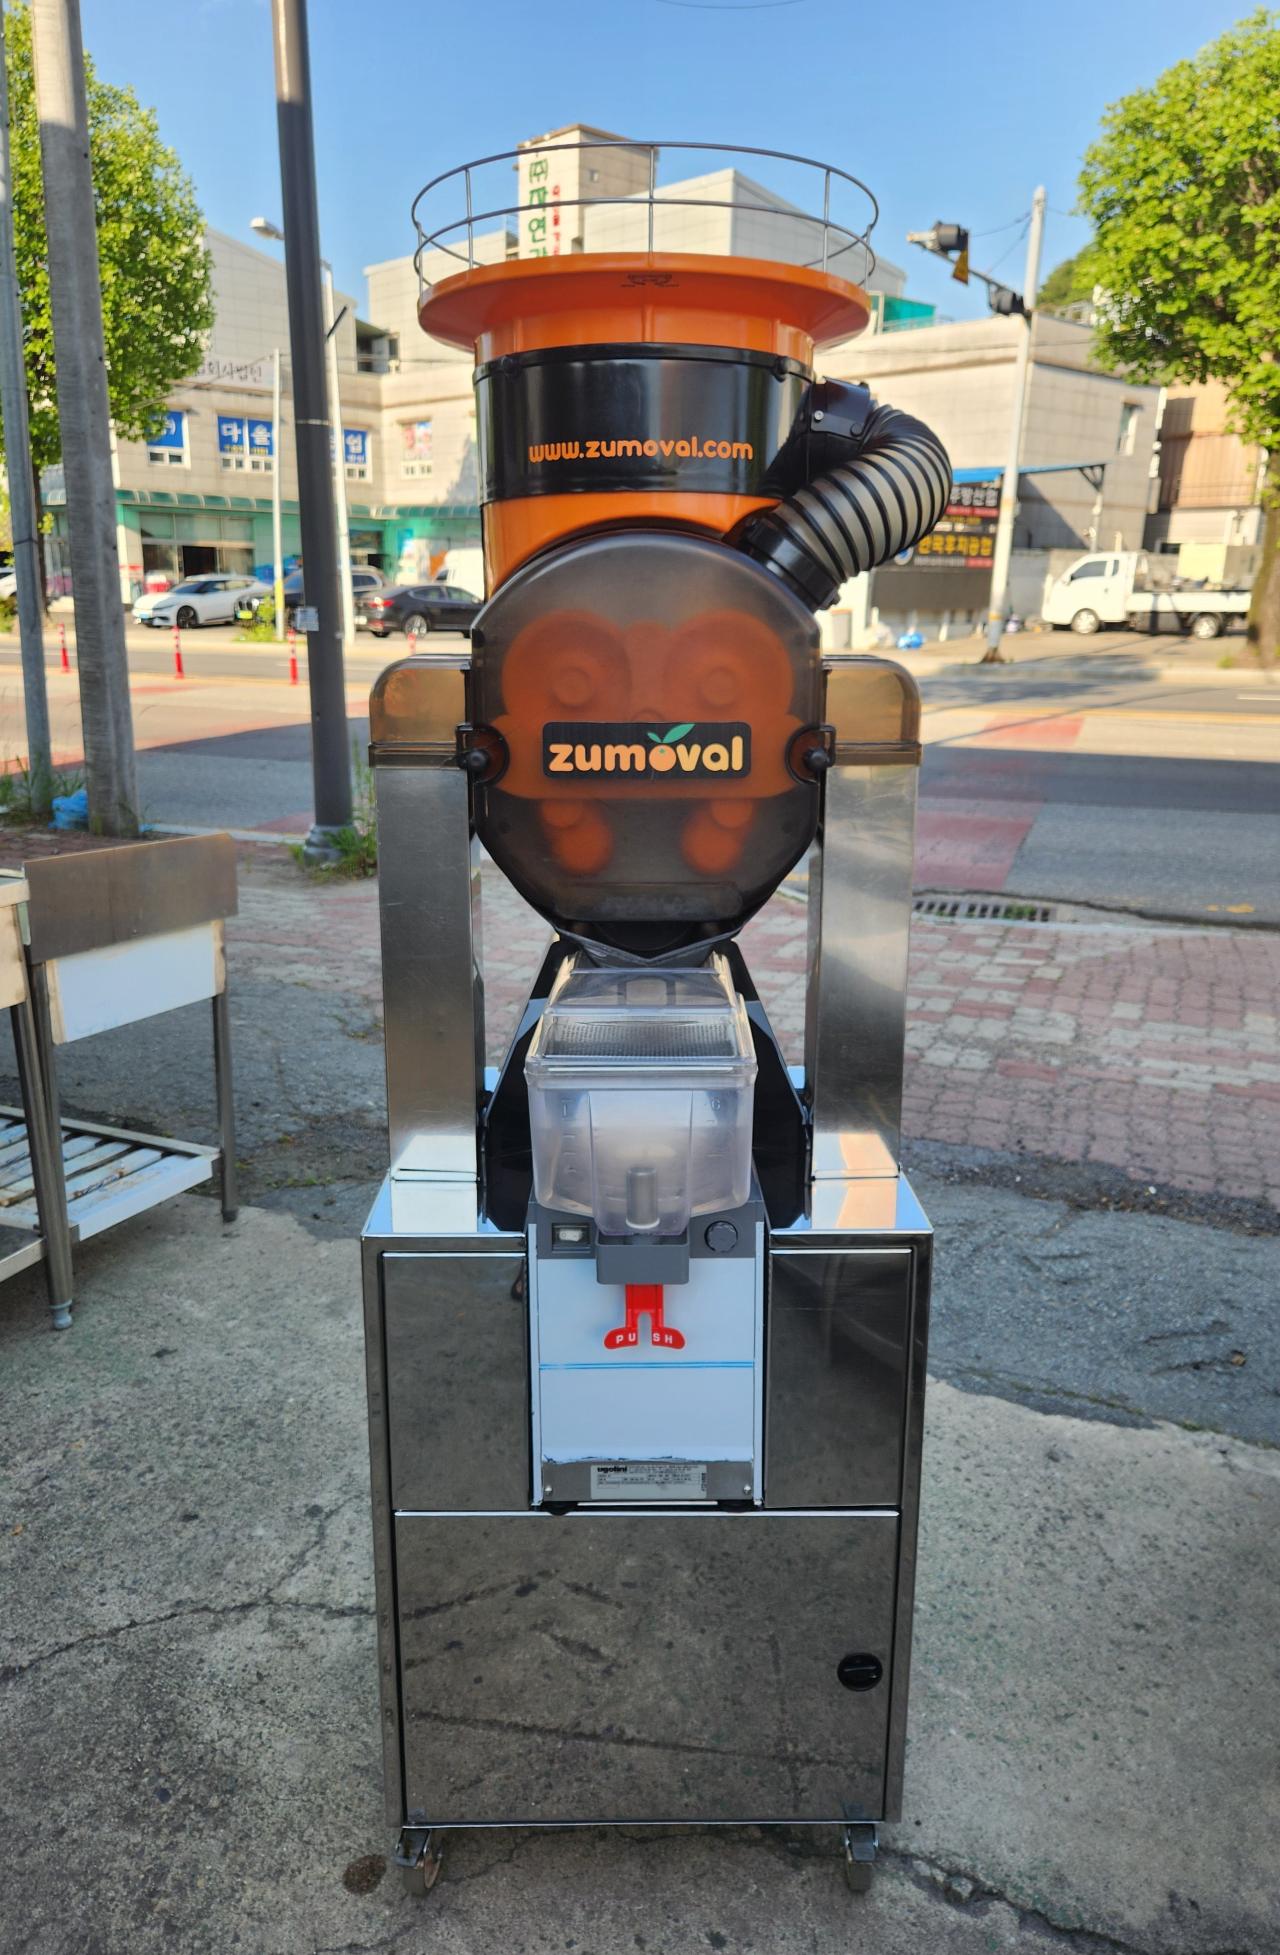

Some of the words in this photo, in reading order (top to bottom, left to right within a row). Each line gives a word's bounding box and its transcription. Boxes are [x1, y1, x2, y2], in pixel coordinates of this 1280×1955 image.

[528, 436, 753, 463] www.zumoval.com
[549, 735, 743, 772] zumoval
[615, 1332, 673, 1345] PUSH
[597, 1466, 628, 1474] ugolini
